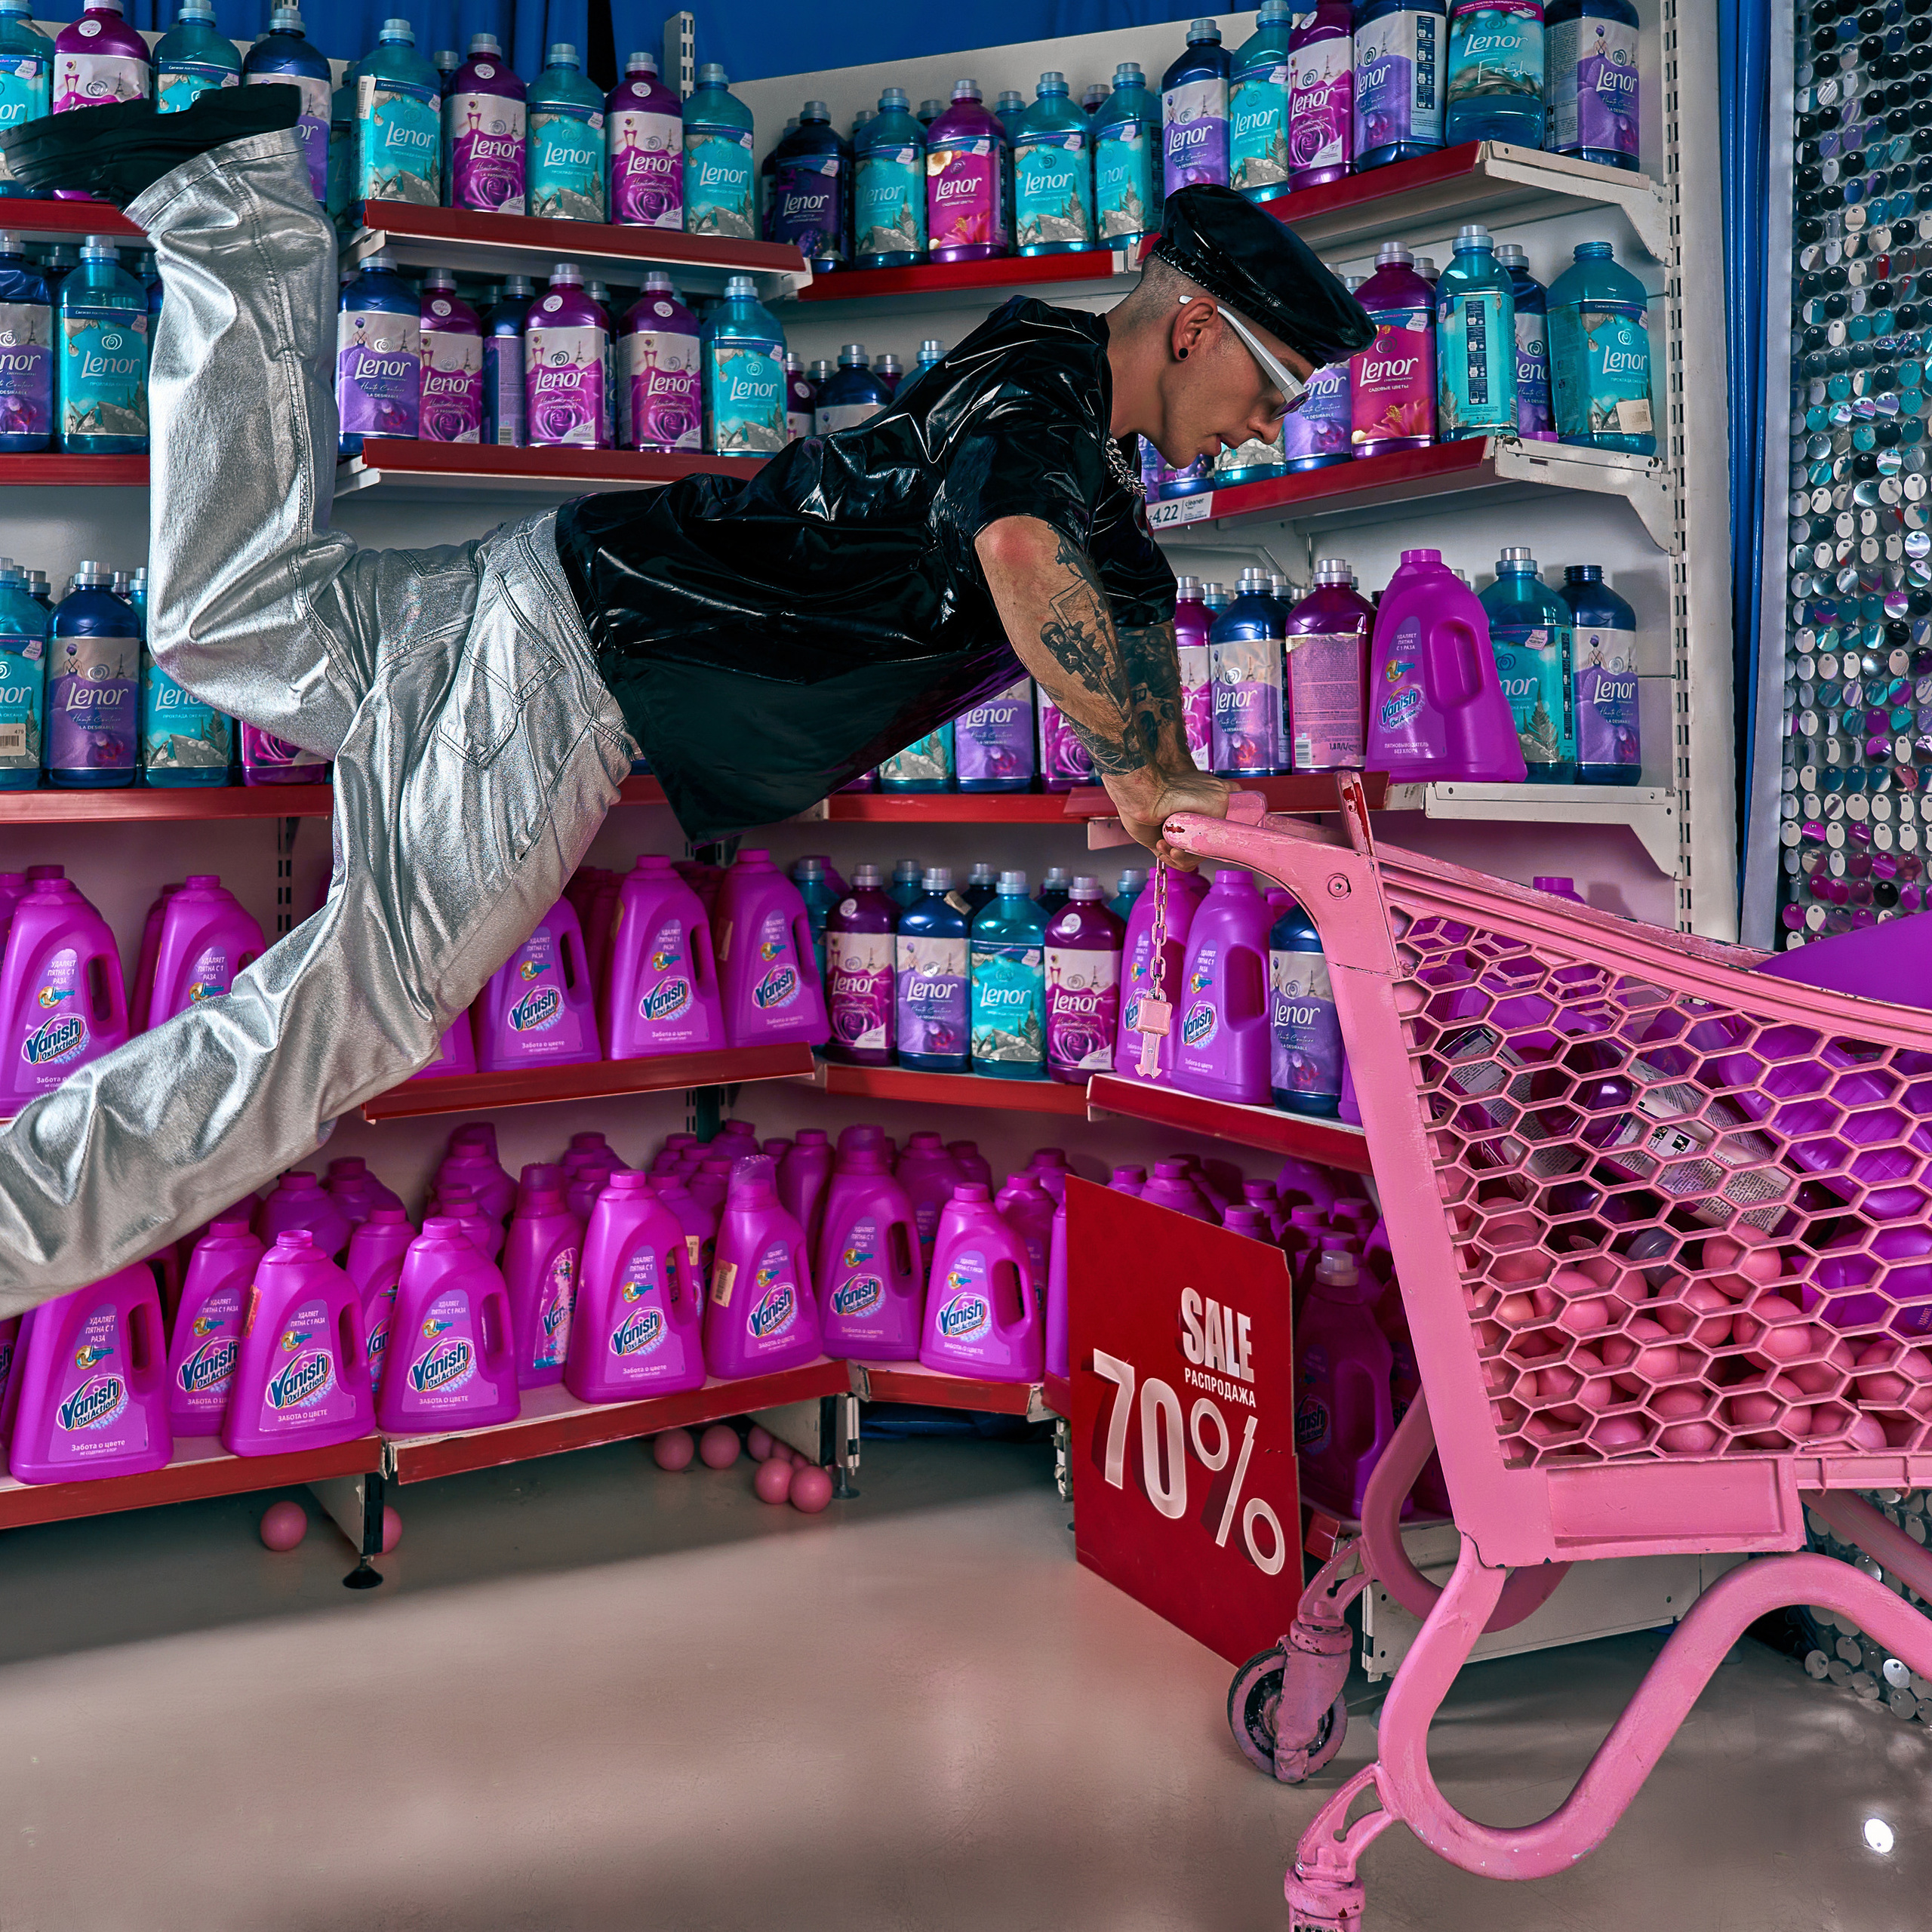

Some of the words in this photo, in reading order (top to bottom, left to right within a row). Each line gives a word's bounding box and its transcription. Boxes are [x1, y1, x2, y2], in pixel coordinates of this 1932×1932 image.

[1463, 34, 1529, 57] Lenor
[1355, 63, 1391, 102] Lenor
[1477, 57, 1534, 84] Fresh
[1595, 63, 1638, 93] Lenor
[1291, 87, 1336, 122] Lenor
[385, 121, 435, 148] Lenor
[1234, 108, 1279, 140] Lenor
[469, 134, 521, 160] Lenor
[543, 142, 595, 167] Lenor
[1168, 125, 1213, 156] Lenor
[626, 151, 678, 176] Lenor
[700, 162, 747, 186] Lenor
[935, 177, 983, 202] Lenor
[1024, 172, 1074, 197] Lenor
[783, 193, 829, 217] Lenor
[81, 350, 140, 378] Lenor
[355, 353, 411, 380] Lenor
[1359, 357, 1419, 387] Lenor
[1602, 345, 1647, 374] Lenor
[423, 371, 474, 396] Lenor
[535, 369, 588, 395] Lenor
[648, 371, 695, 396] Lenor
[729, 377, 778, 401] Lenor
[1303, 376, 1347, 400] enor
[66, 681, 129, 712] Lenor
[1500, 676, 1537, 696] nor
[1593, 675, 1635, 705] Lenor
[1215, 687, 1258, 715] Lenor
[1380, 688, 1417, 723] Vanish
[965, 706, 1018, 729] Lenor
[51, 960, 76, 968] УДАЛЯЕТ
[755, 964, 793, 1008] Vanish
[832, 971, 879, 995] Lenor
[906, 977, 958, 1001] Lenor
[980, 983, 1032, 1007] Lenor
[511, 985, 558, 1031] Vanish
[643, 977, 685, 1020] Vanish
[1052, 989, 1104, 1014] Lenor
[1274, 998, 1321, 1027] Lenor
[1183, 1002, 1212, 1044] Vanish
[26, 1014, 82, 1065] Vanish
[41, 1048, 54, 1061] Oxi
[54, 1036, 78, 1054] Action
[834, 1275, 877, 1315] Vanish
[90, 1315, 115, 1324] УДАЛЯЕТ
[751, 1286, 792, 1338] Vanish
[940, 1294, 984, 1335] Vanish
[613, 1309, 659, 1356] Vanish
[1181, 1287, 1254, 1383] SALE
[182, 1338, 238, 1392] Vanish
[197, 1375, 211, 1389] Oxi
[210, 1361, 236, 1381] Action
[413, 1340, 468, 1392] Vanish
[428, 1377, 441, 1389] Oxi
[441, 1362, 466, 1383] Action
[270, 1351, 327, 1409] Vanish
[287, 1392, 300, 1404] Oxi
[300, 1374, 325, 1398] Action
[1184, 1367, 1257, 1407] РАСПРОДАЖА
[61, 1377, 119, 1431] Vanish
[77, 1415, 91, 1427] Oxi
[91, 1398, 116, 1419] Action
[309, 1409, 328, 1417] ЦВЕТЕ
[72, 1444, 97, 1452] Забота
[104, 1439, 125, 1449] цвете
[1093, 1348, 1284, 1576] 70%
